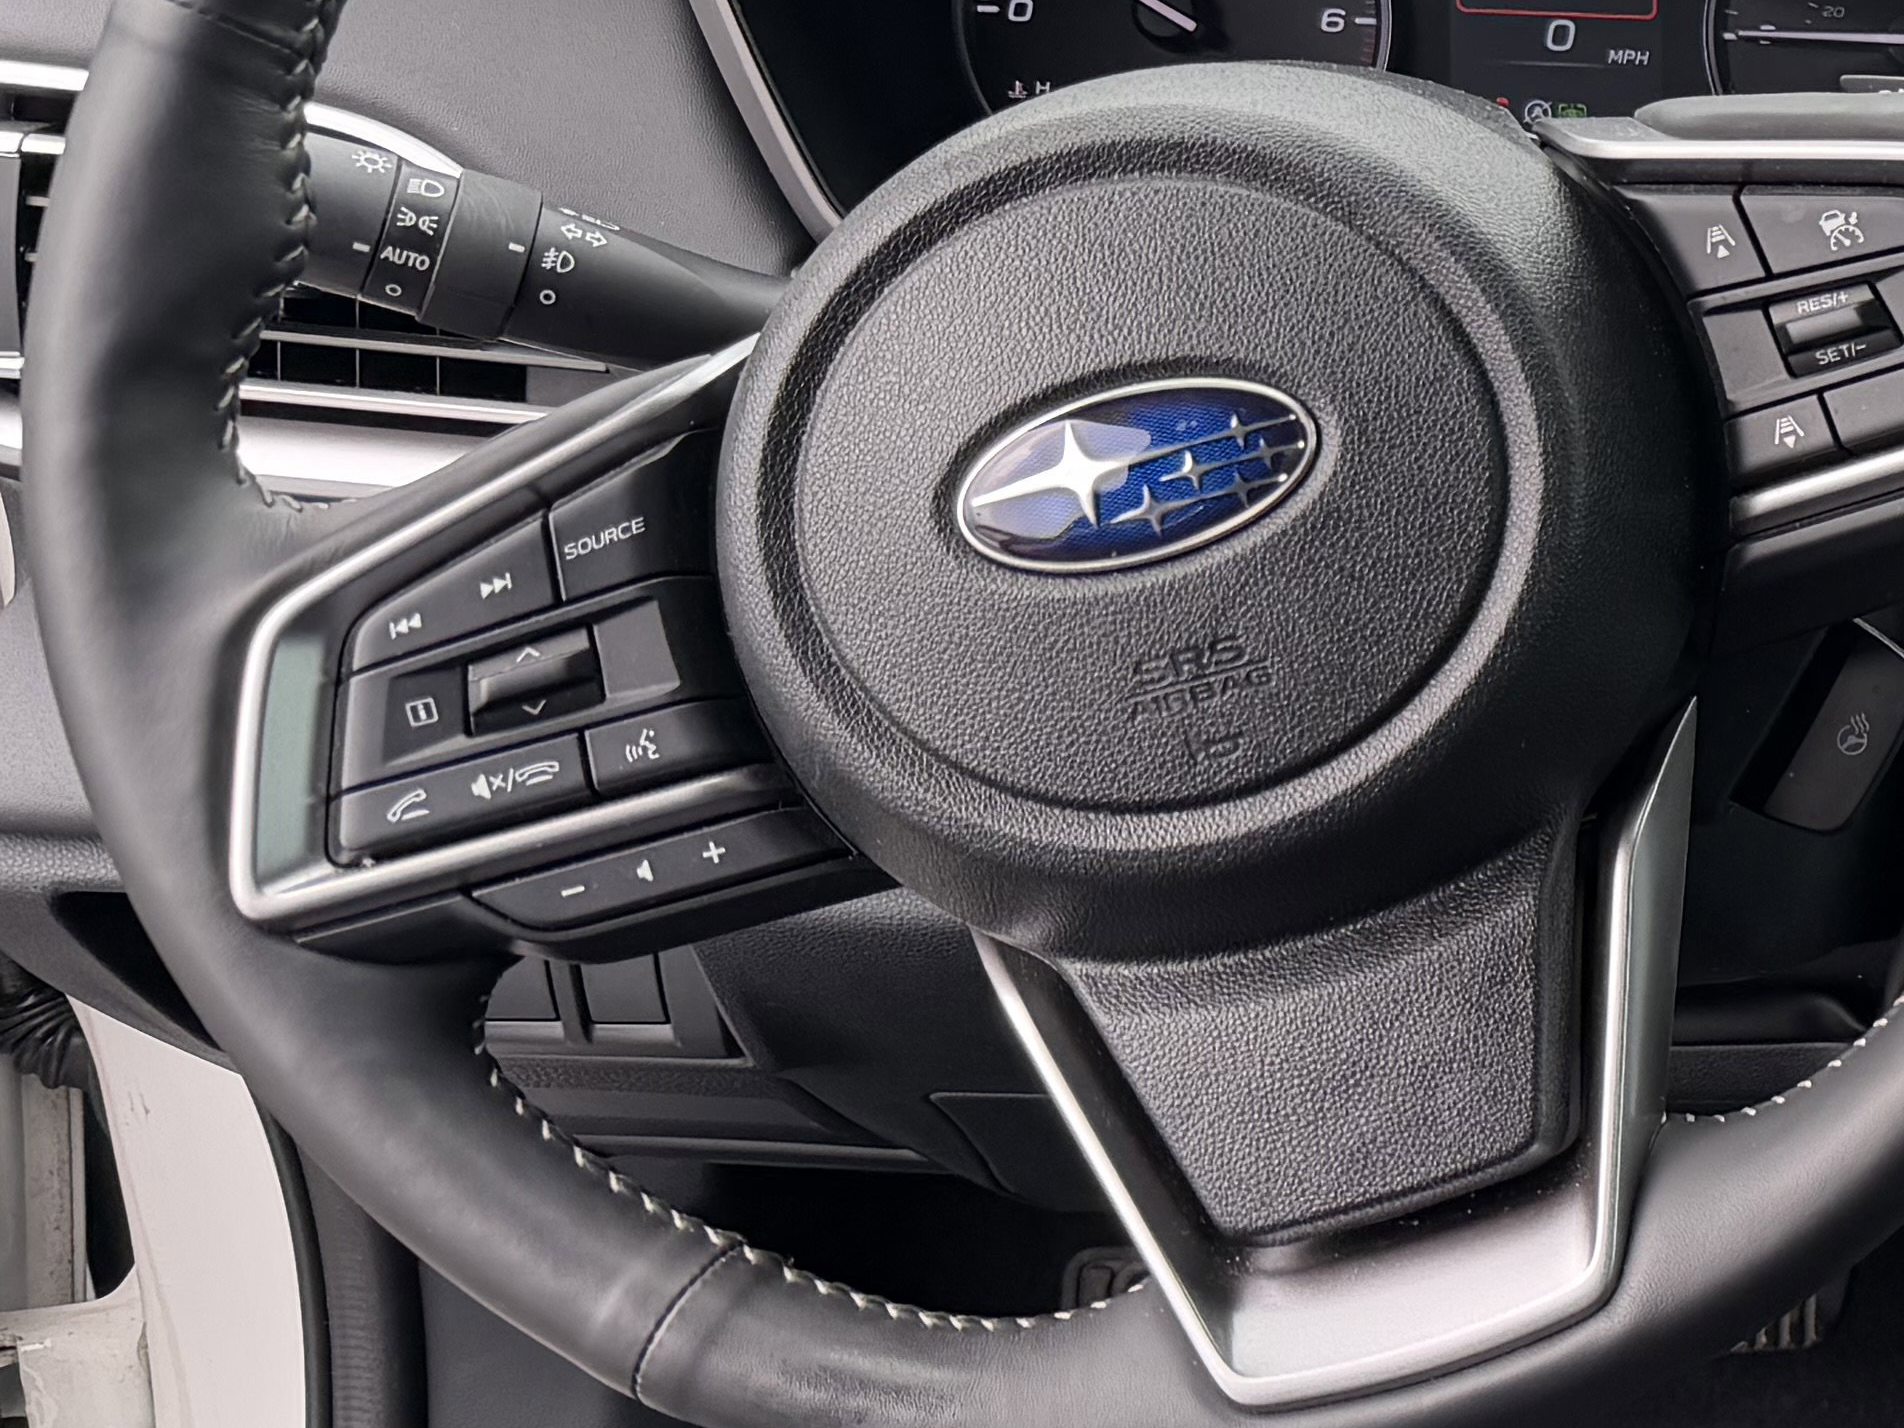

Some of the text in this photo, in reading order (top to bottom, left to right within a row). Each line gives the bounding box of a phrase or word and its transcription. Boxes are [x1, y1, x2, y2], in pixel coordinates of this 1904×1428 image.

[1320, 9, 1346, 34] 6
[1822, 6, 1845, 18] 20
[1546, 19, 1576, 52] 0
[1607, 49, 1650, 66] MPH
[379, 245, 430, 271] AUTO
[563, 515, 646, 560] SOURCE
